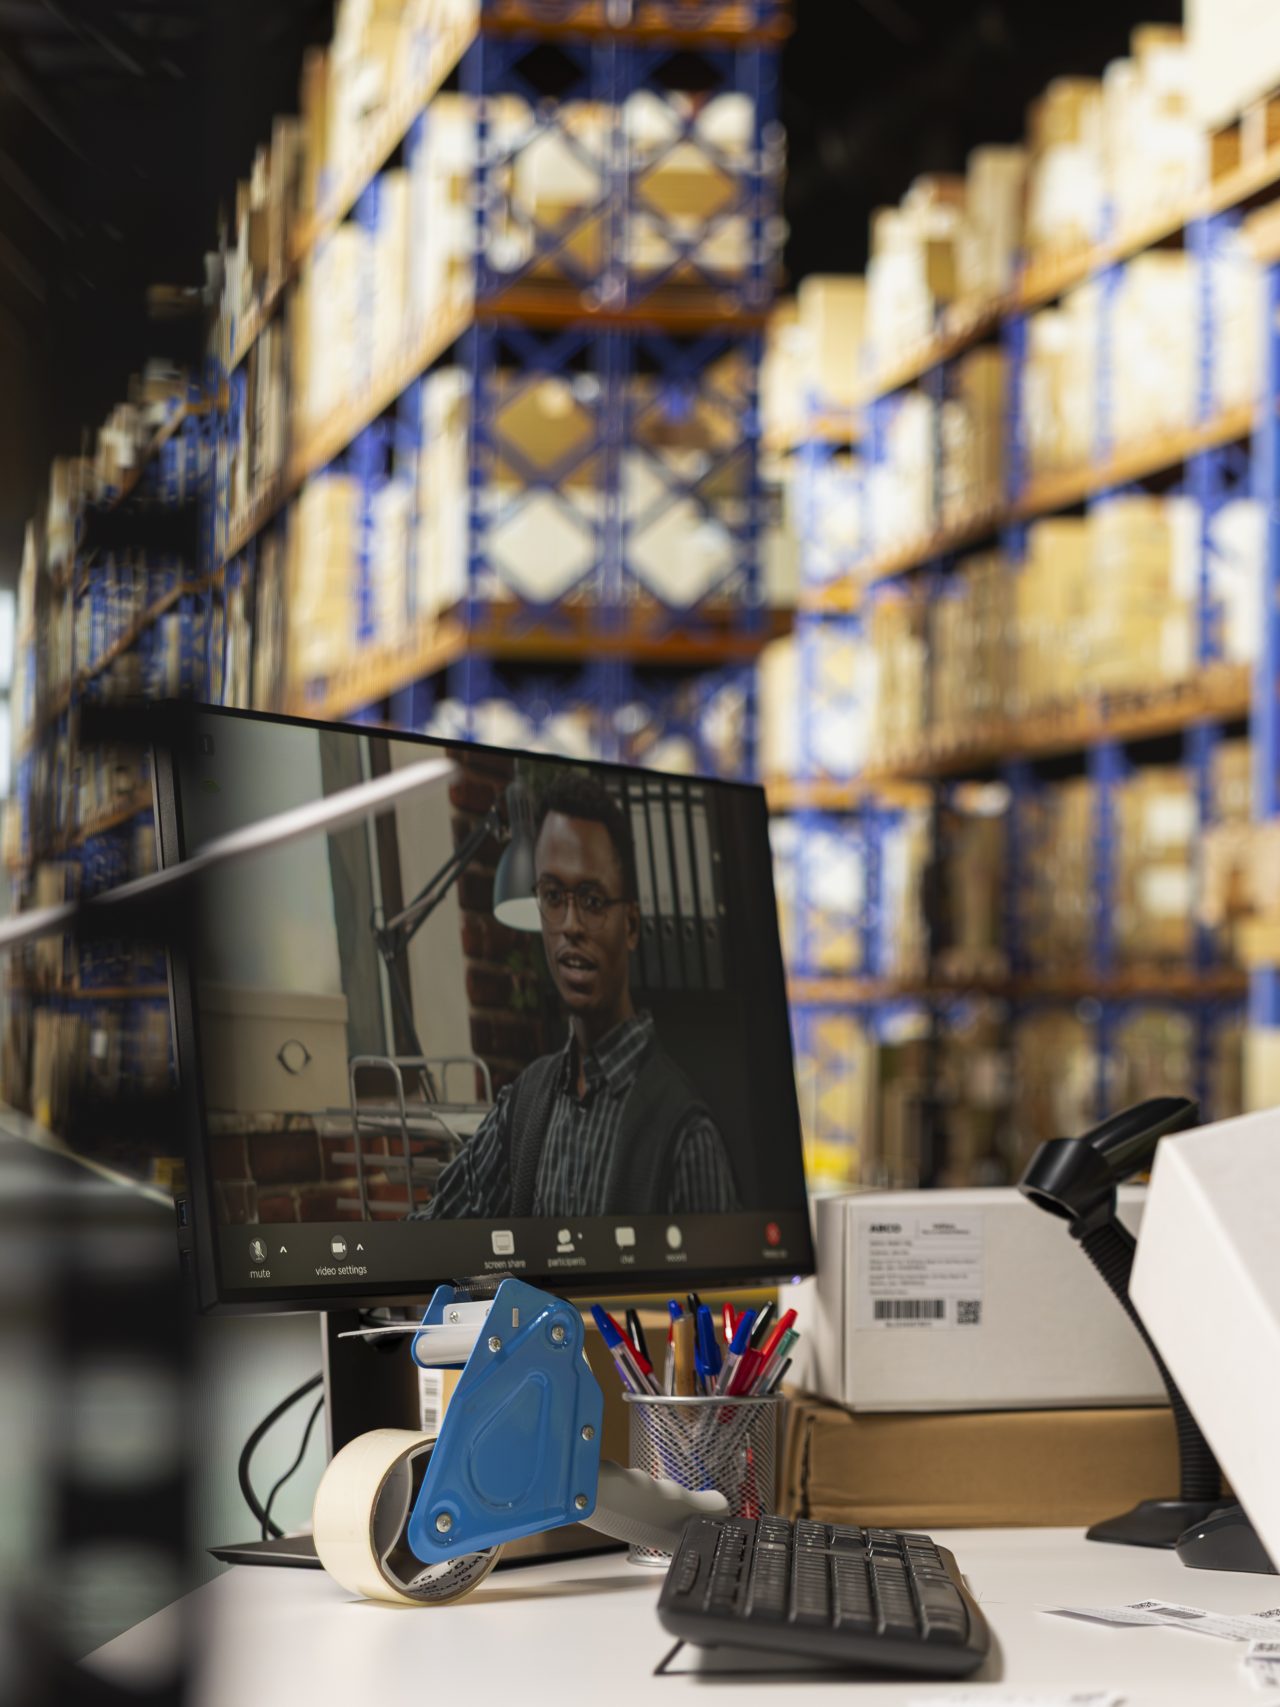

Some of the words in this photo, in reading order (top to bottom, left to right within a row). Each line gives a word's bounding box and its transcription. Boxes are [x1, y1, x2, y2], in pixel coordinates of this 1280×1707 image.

[484, 1260, 506, 1270] screen
[507, 1258, 526, 1269] share
[249, 1269, 272, 1279] mute
[315, 1266, 336, 1277] video
[338, 1265, 368, 1277] settings
